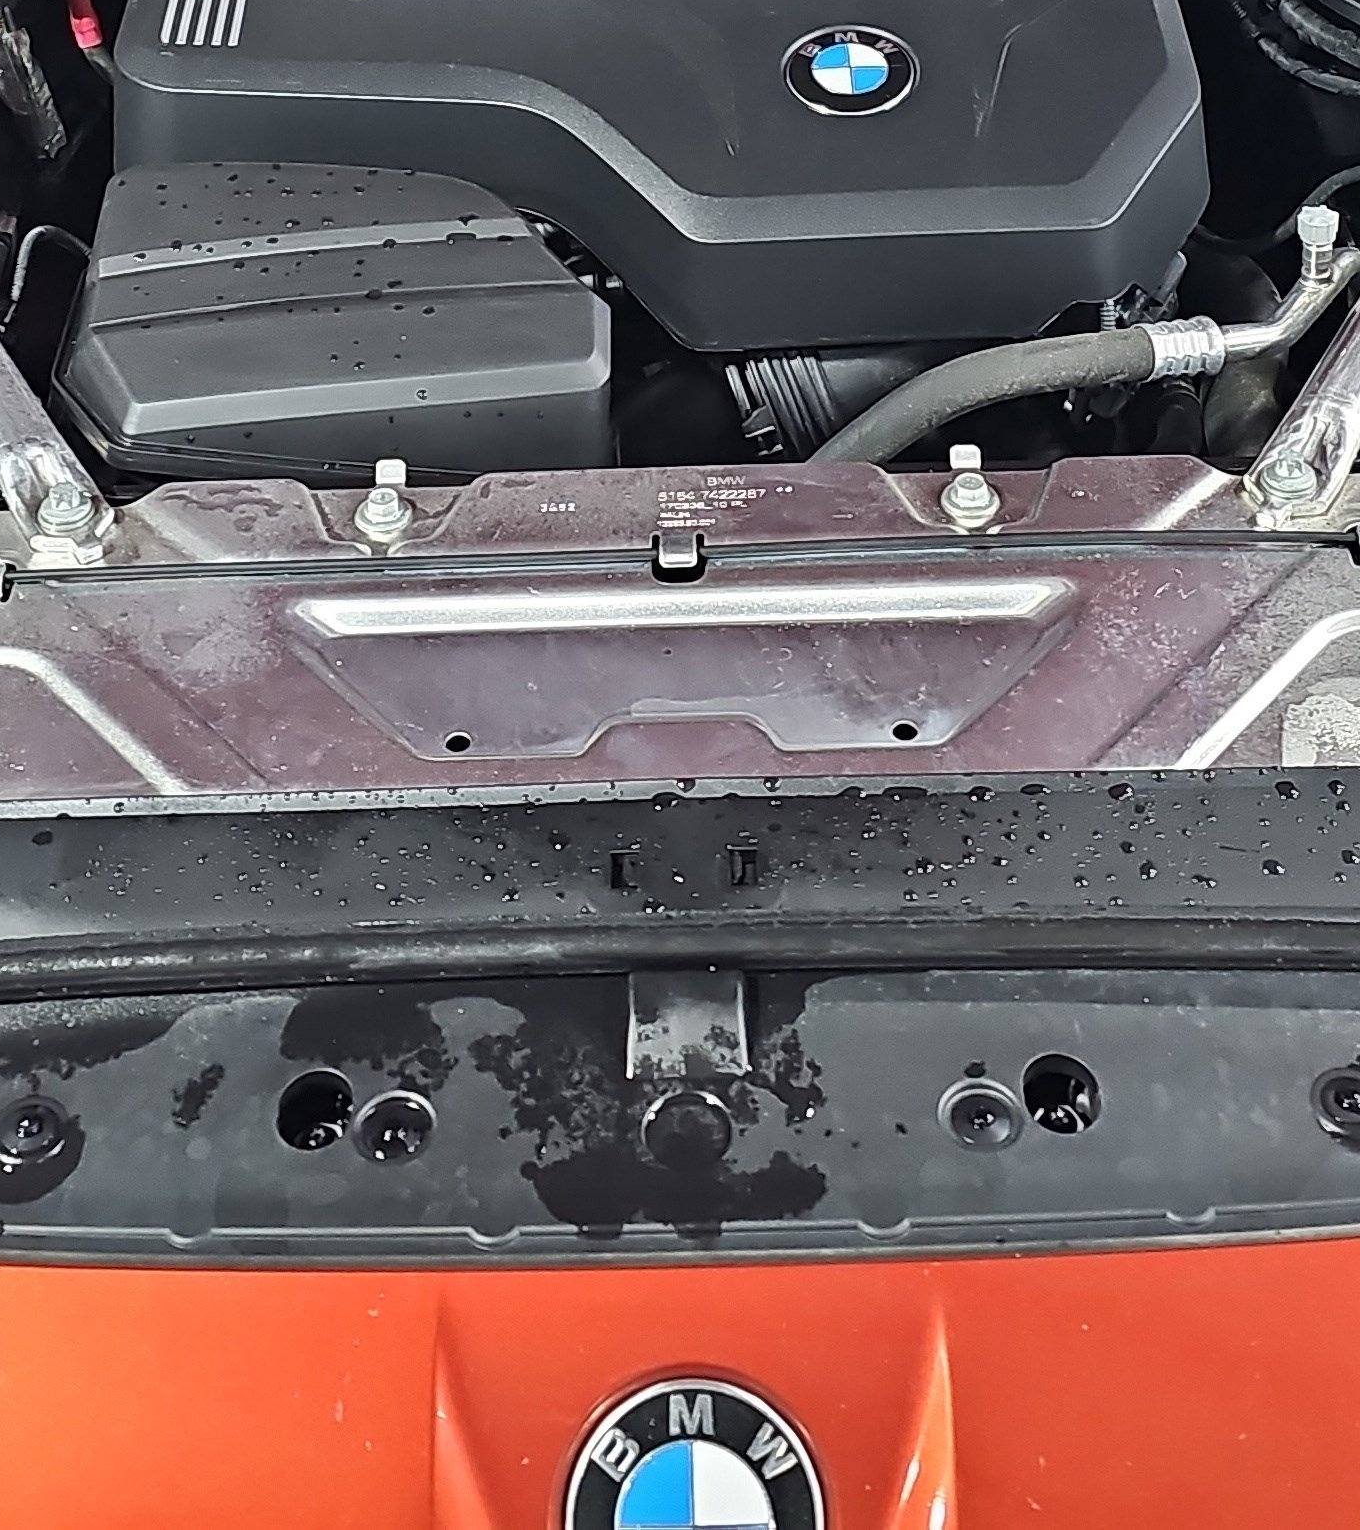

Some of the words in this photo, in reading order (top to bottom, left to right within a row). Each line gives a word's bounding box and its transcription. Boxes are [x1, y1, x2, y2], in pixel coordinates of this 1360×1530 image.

[798, 31, 900, 58] BMW
[706, 475, 746, 487] BMW
[590, 1393, 799, 1483] BMW
